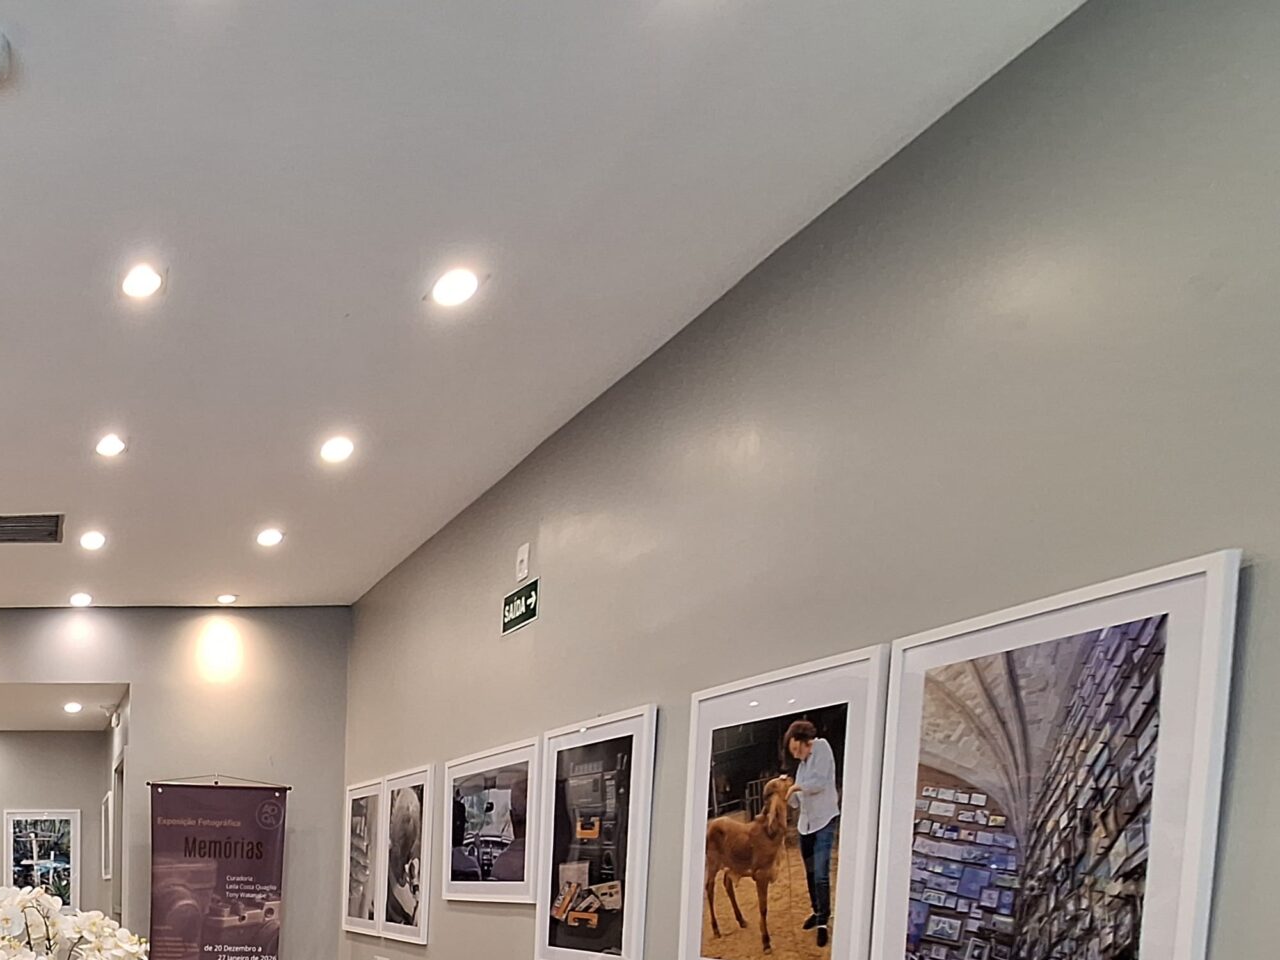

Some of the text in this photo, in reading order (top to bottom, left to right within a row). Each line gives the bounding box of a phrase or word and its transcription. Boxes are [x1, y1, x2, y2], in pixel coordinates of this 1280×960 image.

[504, 596, 526, 623] SAÍDA
[157, 817, 241, 828] Exposição Fotográfica
[184, 836, 264, 860] Memórias
[204, 944, 213, 952] de
[214, 944, 223, 952] 20
[224, 945, 257, 953] Dezembro
